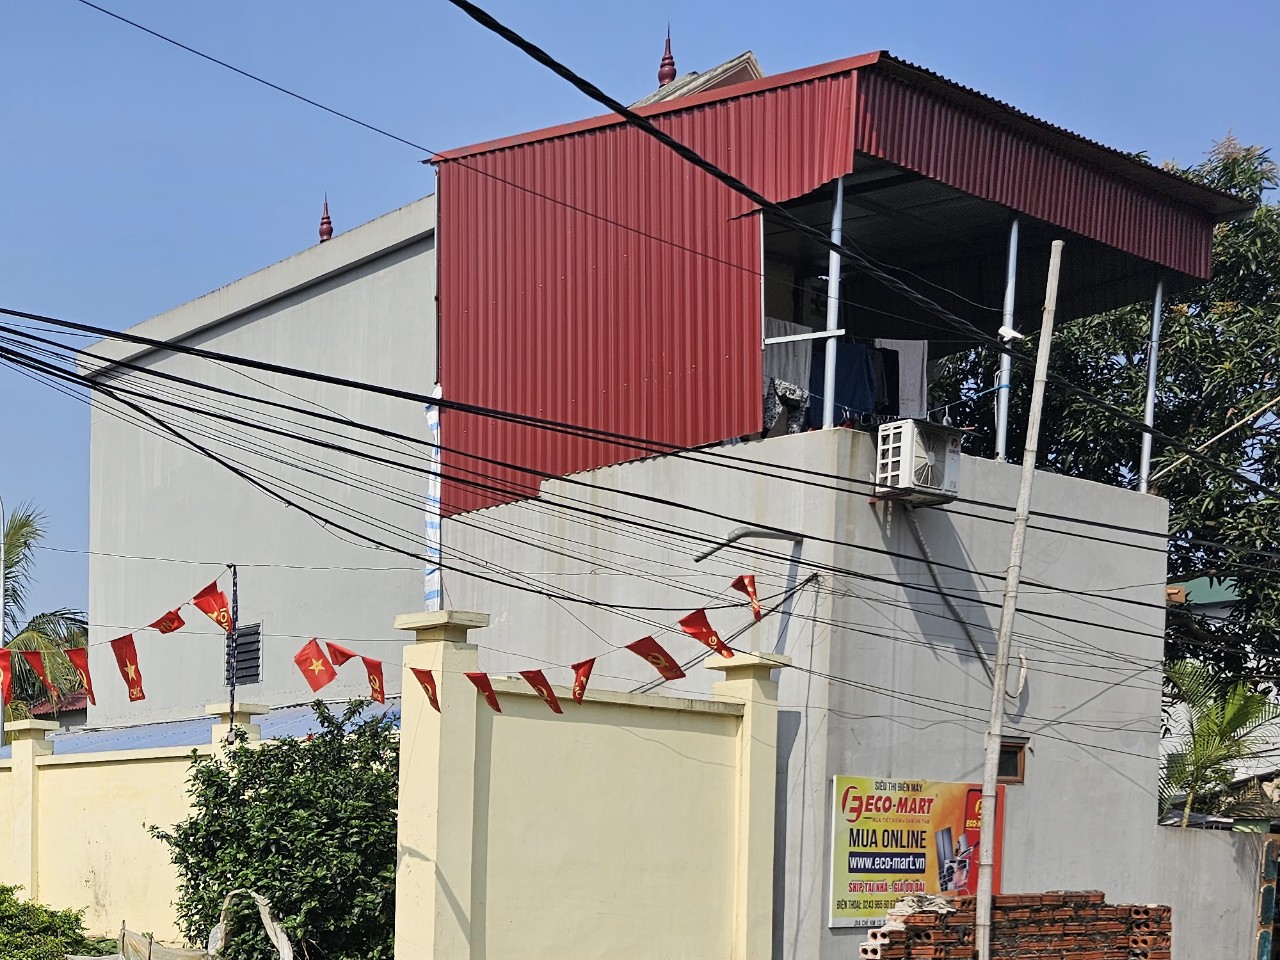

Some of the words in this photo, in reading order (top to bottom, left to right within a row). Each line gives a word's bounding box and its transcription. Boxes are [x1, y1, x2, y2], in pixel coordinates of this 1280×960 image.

[874, 780, 887, 791] SIÊU
[888, 782, 897, 793] THỊ
[897, 781, 910, 793] ĐIỆN
[910, 782, 923, 792] MÁY
[863, 795, 935, 815] ECO-MART
[848, 828, 878, 848] MUA
[882, 829, 927, 849] ONLINE
[849, 854, 925, 869] www.eco-mart.vn
[848, 882, 864, 893] SHIP
[836, 898, 847, 911] ĐIỆN
